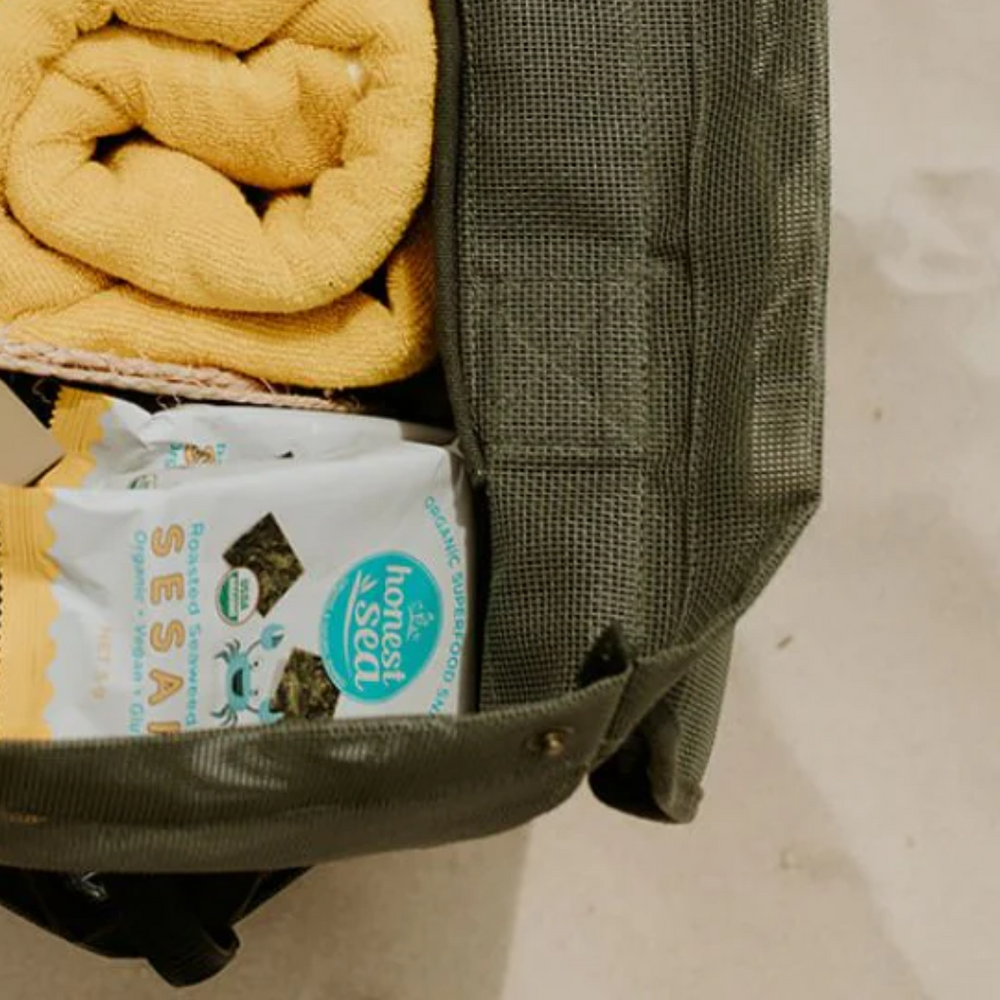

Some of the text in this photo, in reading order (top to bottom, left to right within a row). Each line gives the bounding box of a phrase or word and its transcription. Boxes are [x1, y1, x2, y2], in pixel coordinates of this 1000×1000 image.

[132, 530, 148, 603] Organic
[132, 624, 147, 682] Vegan
[186, 523, 205, 726] Roasted Seaweed
[354, 600, 380, 692] sea
[382, 564, 412, 687] honest
